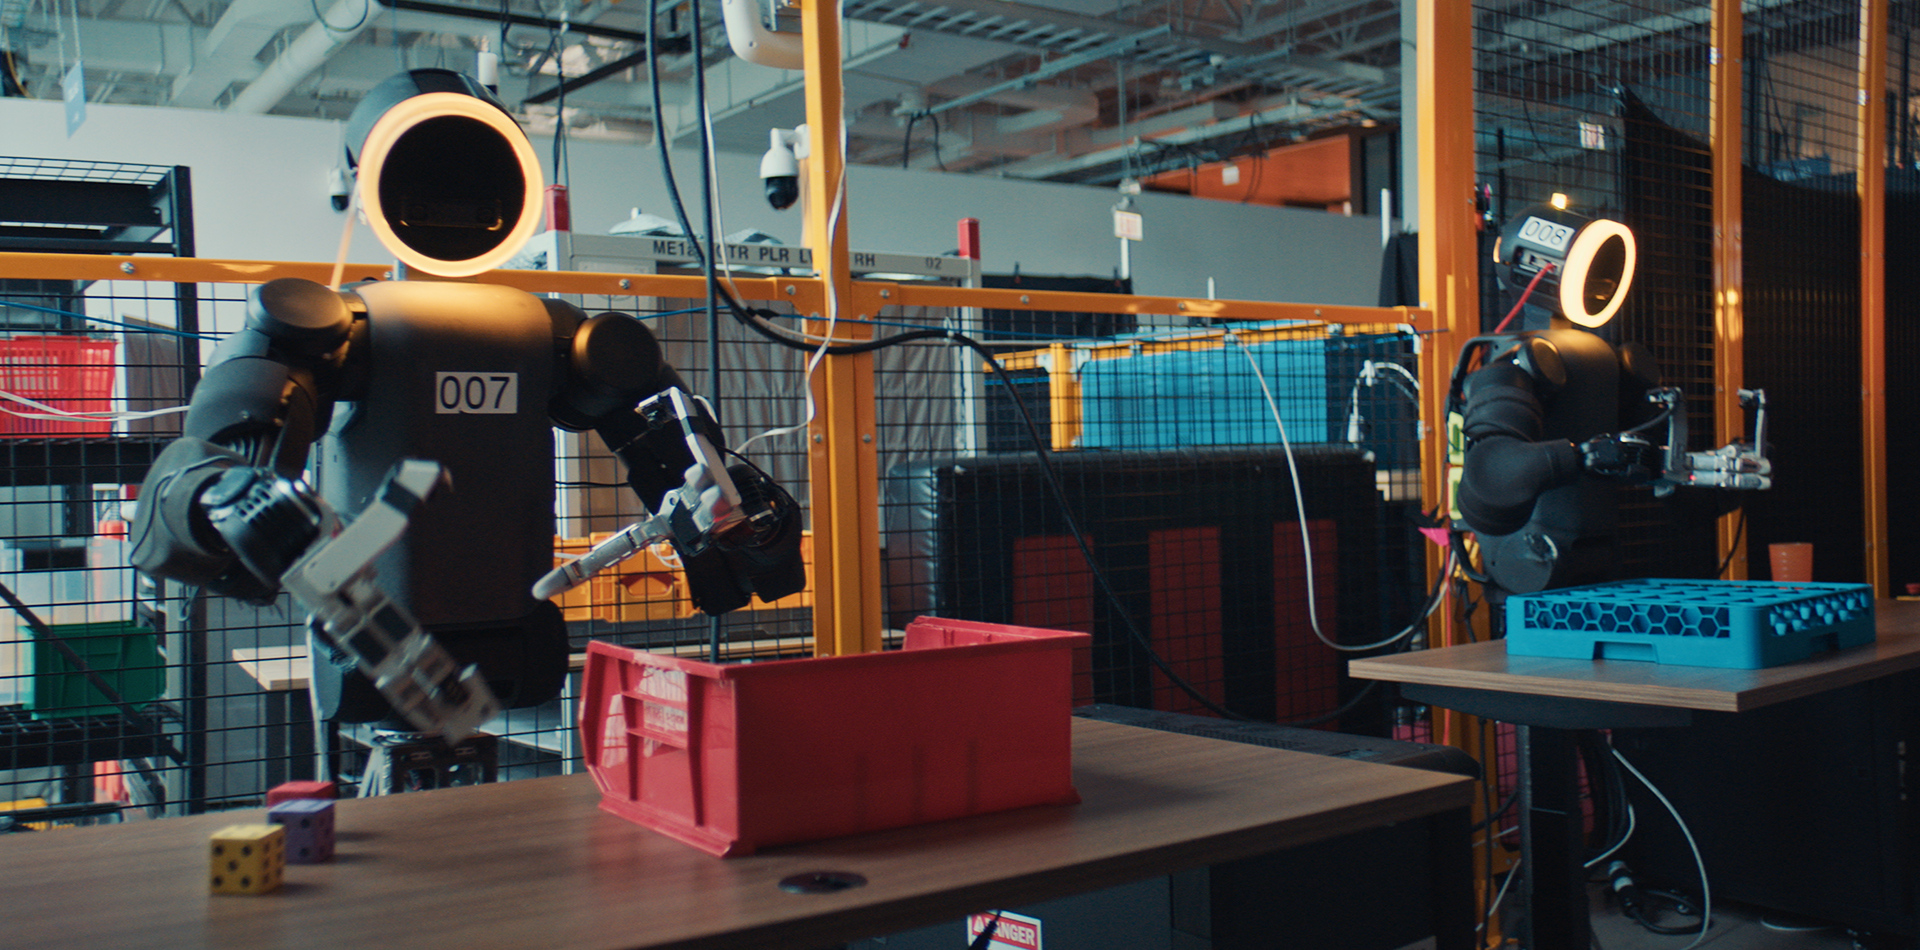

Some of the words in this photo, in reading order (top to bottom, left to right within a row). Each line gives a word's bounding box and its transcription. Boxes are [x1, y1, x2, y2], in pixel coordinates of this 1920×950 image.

[1525, 220, 1567, 246] 008
[759, 247, 789, 262] PLR
[854, 252, 876, 267] RH
[924, 256, 943, 270] 02
[440, 375, 510, 410] 007
